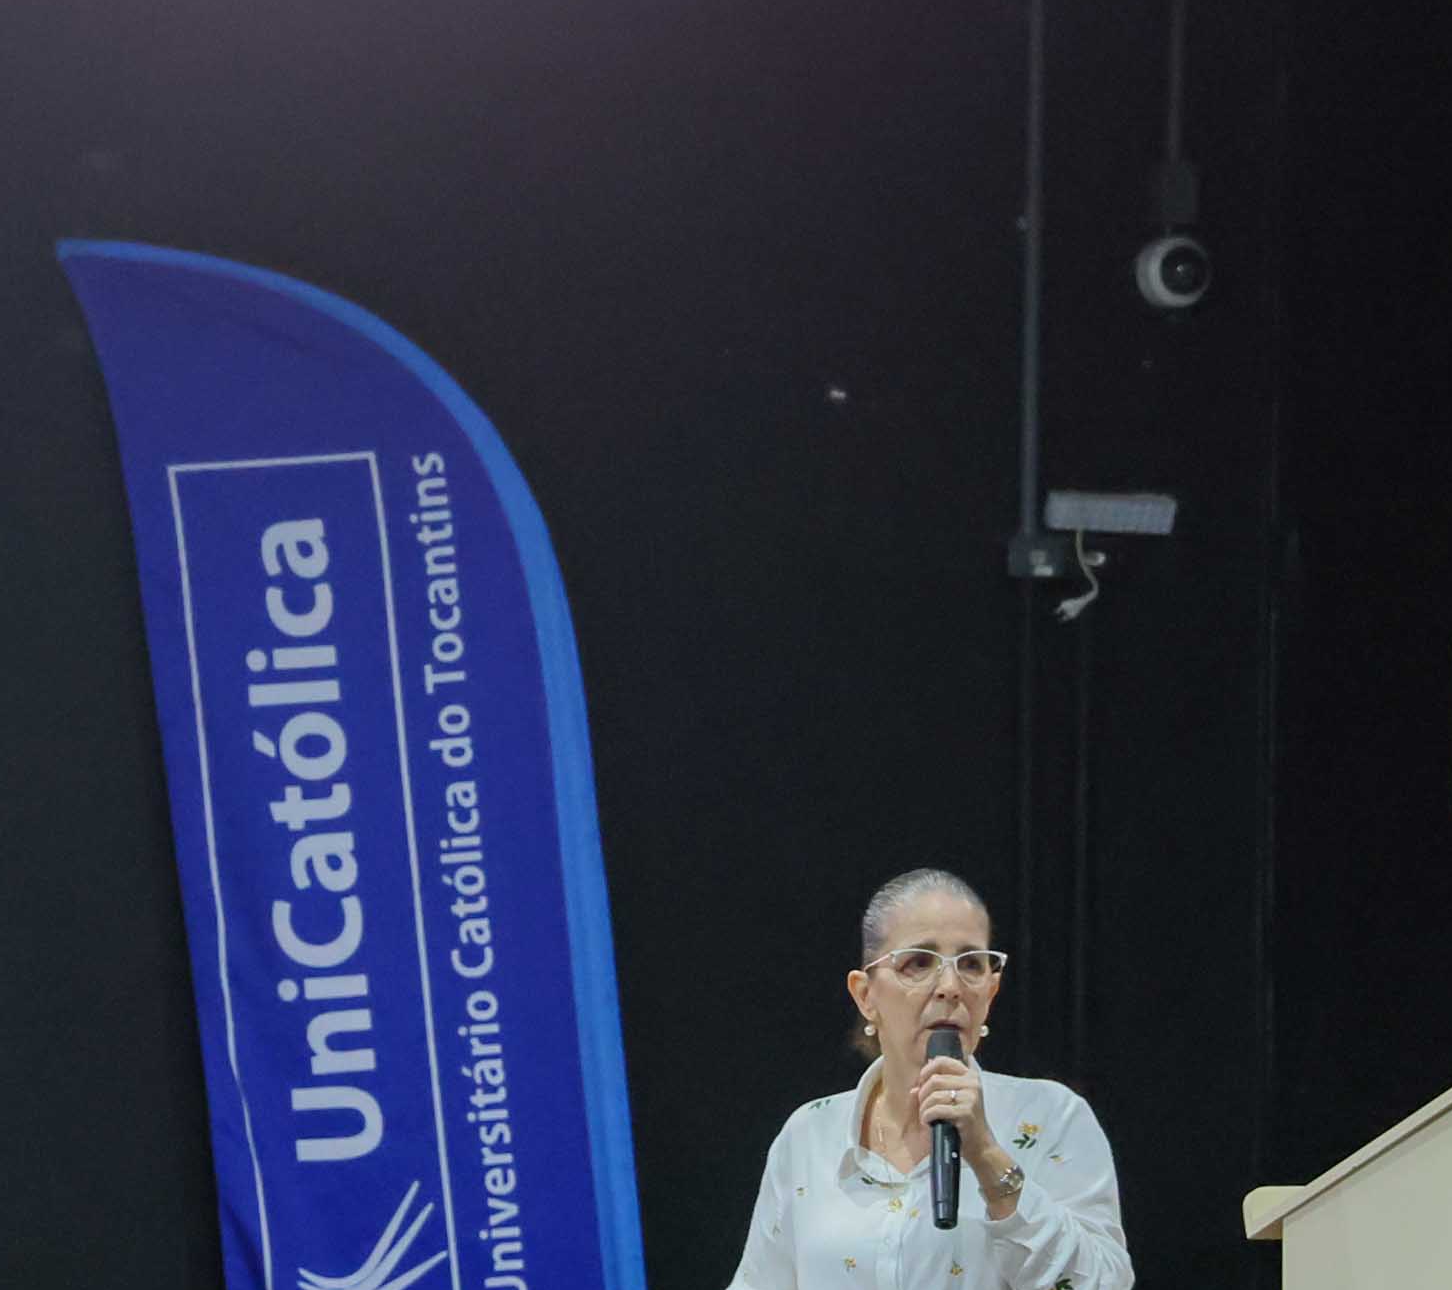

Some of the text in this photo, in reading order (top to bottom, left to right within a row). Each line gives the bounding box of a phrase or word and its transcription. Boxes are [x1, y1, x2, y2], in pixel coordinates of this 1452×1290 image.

[410, 451, 467, 696] Tocantins
[246, 517, 385, 1164] UniCatólica
[429, 704, 474, 768] do
[439, 779, 494, 980] Católica
